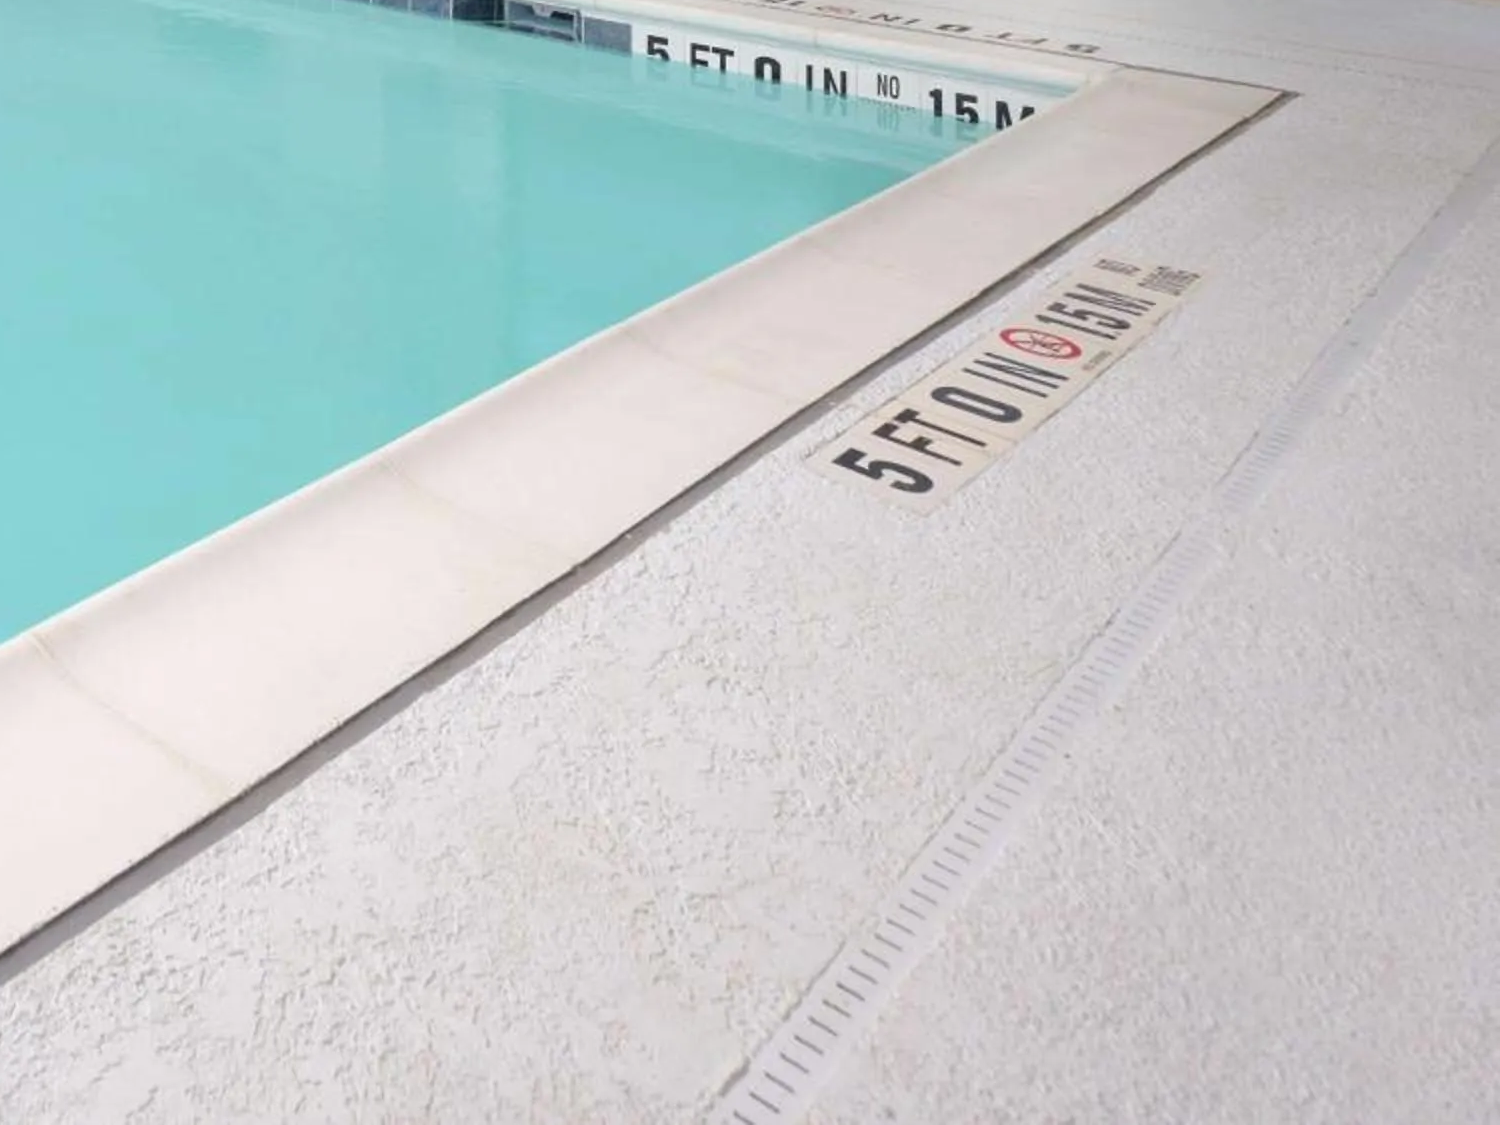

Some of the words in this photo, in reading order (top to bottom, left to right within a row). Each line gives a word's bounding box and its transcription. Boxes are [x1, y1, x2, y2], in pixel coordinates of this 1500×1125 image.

[647, 34, 670, 62] 5
[689, 42, 735, 74] FT
[805, 64, 848, 100] IN
[877, 72, 901, 99] NO
[962, 351, 1070, 398] IN
[930, 385, 1024, 424] 0
[871, 407, 988, 467] FT
[831, 447, 935, 494] 5
